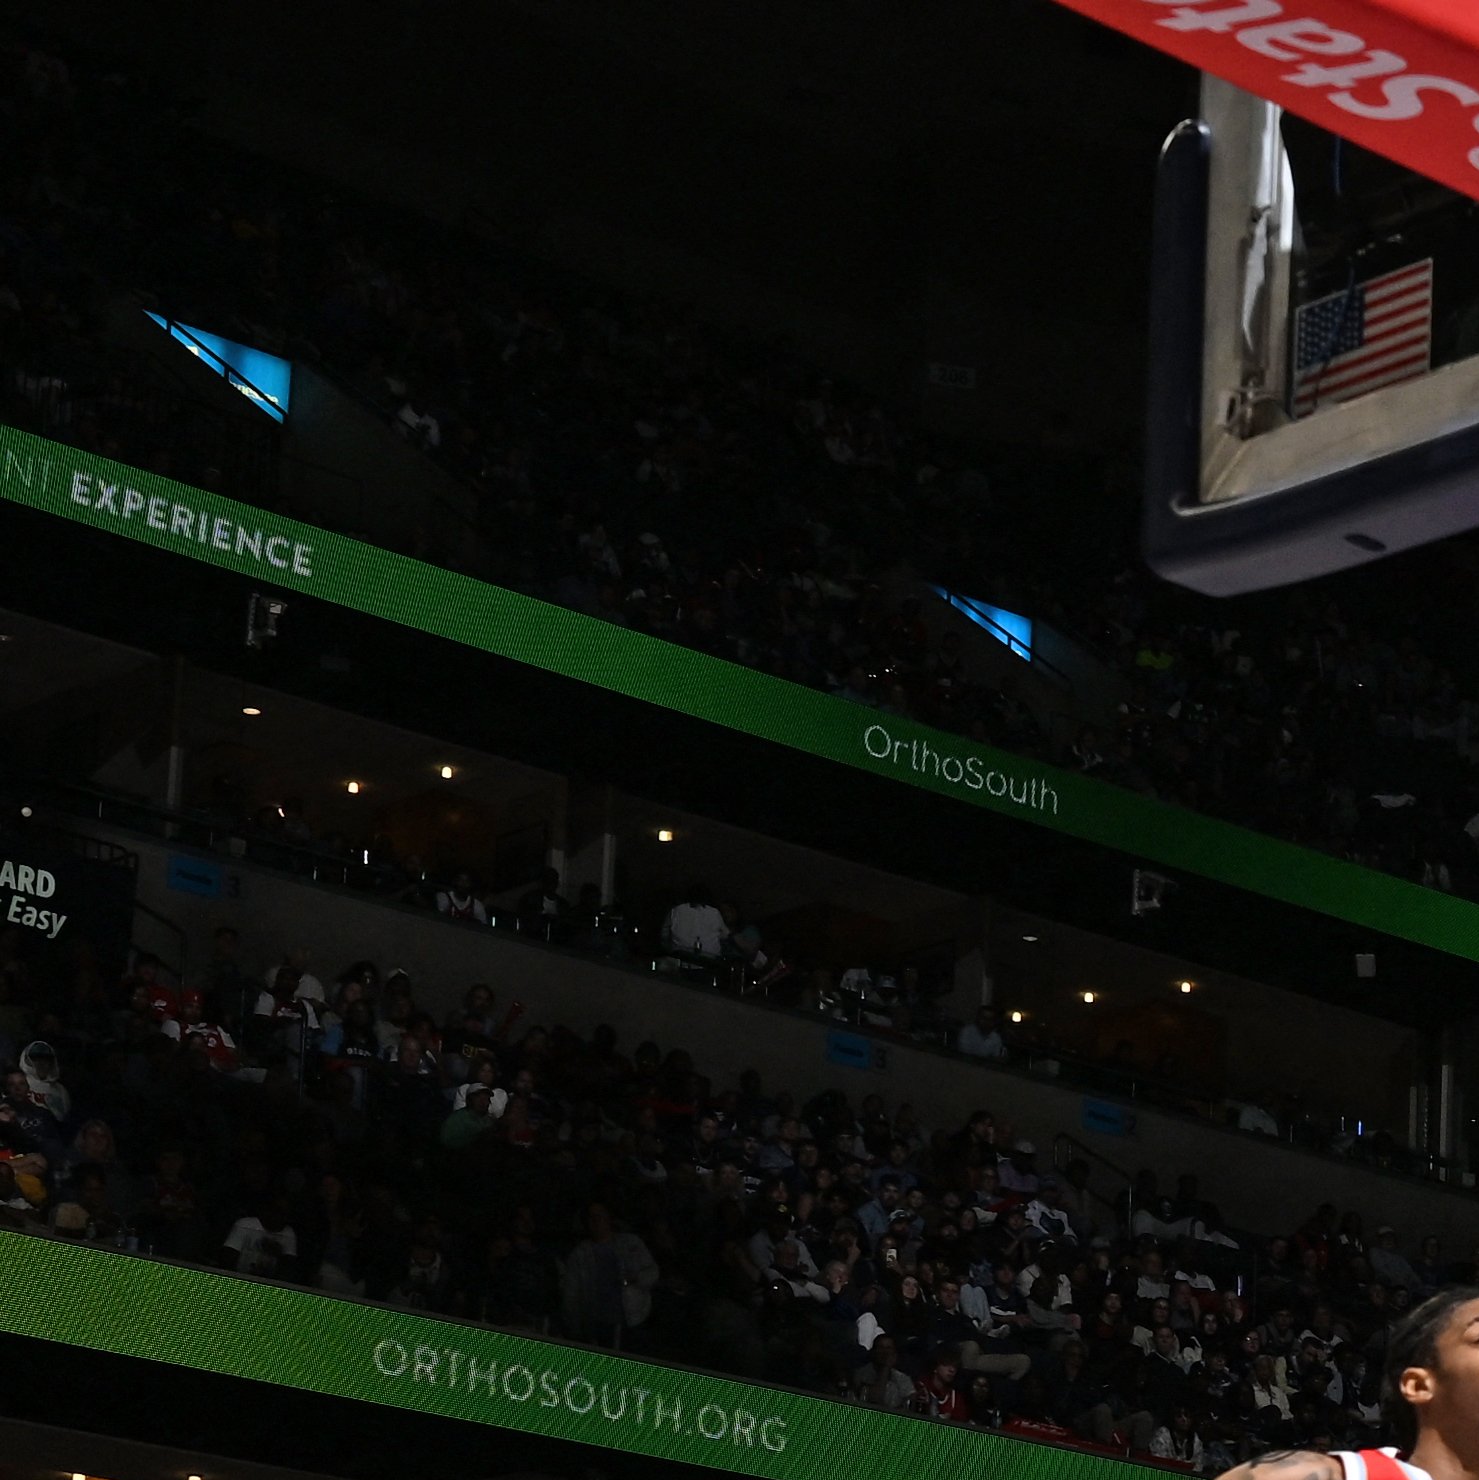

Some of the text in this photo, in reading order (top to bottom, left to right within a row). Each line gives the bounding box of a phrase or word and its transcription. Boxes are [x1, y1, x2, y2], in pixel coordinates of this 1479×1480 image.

[71, 470, 314, 578] EXPERIENCE
[863, 725, 1059, 815] OrthoSouth
[7, 895, 68, 939] Easy
[372, 1338, 788, 1453] ORTHOSOUTH.ORG
